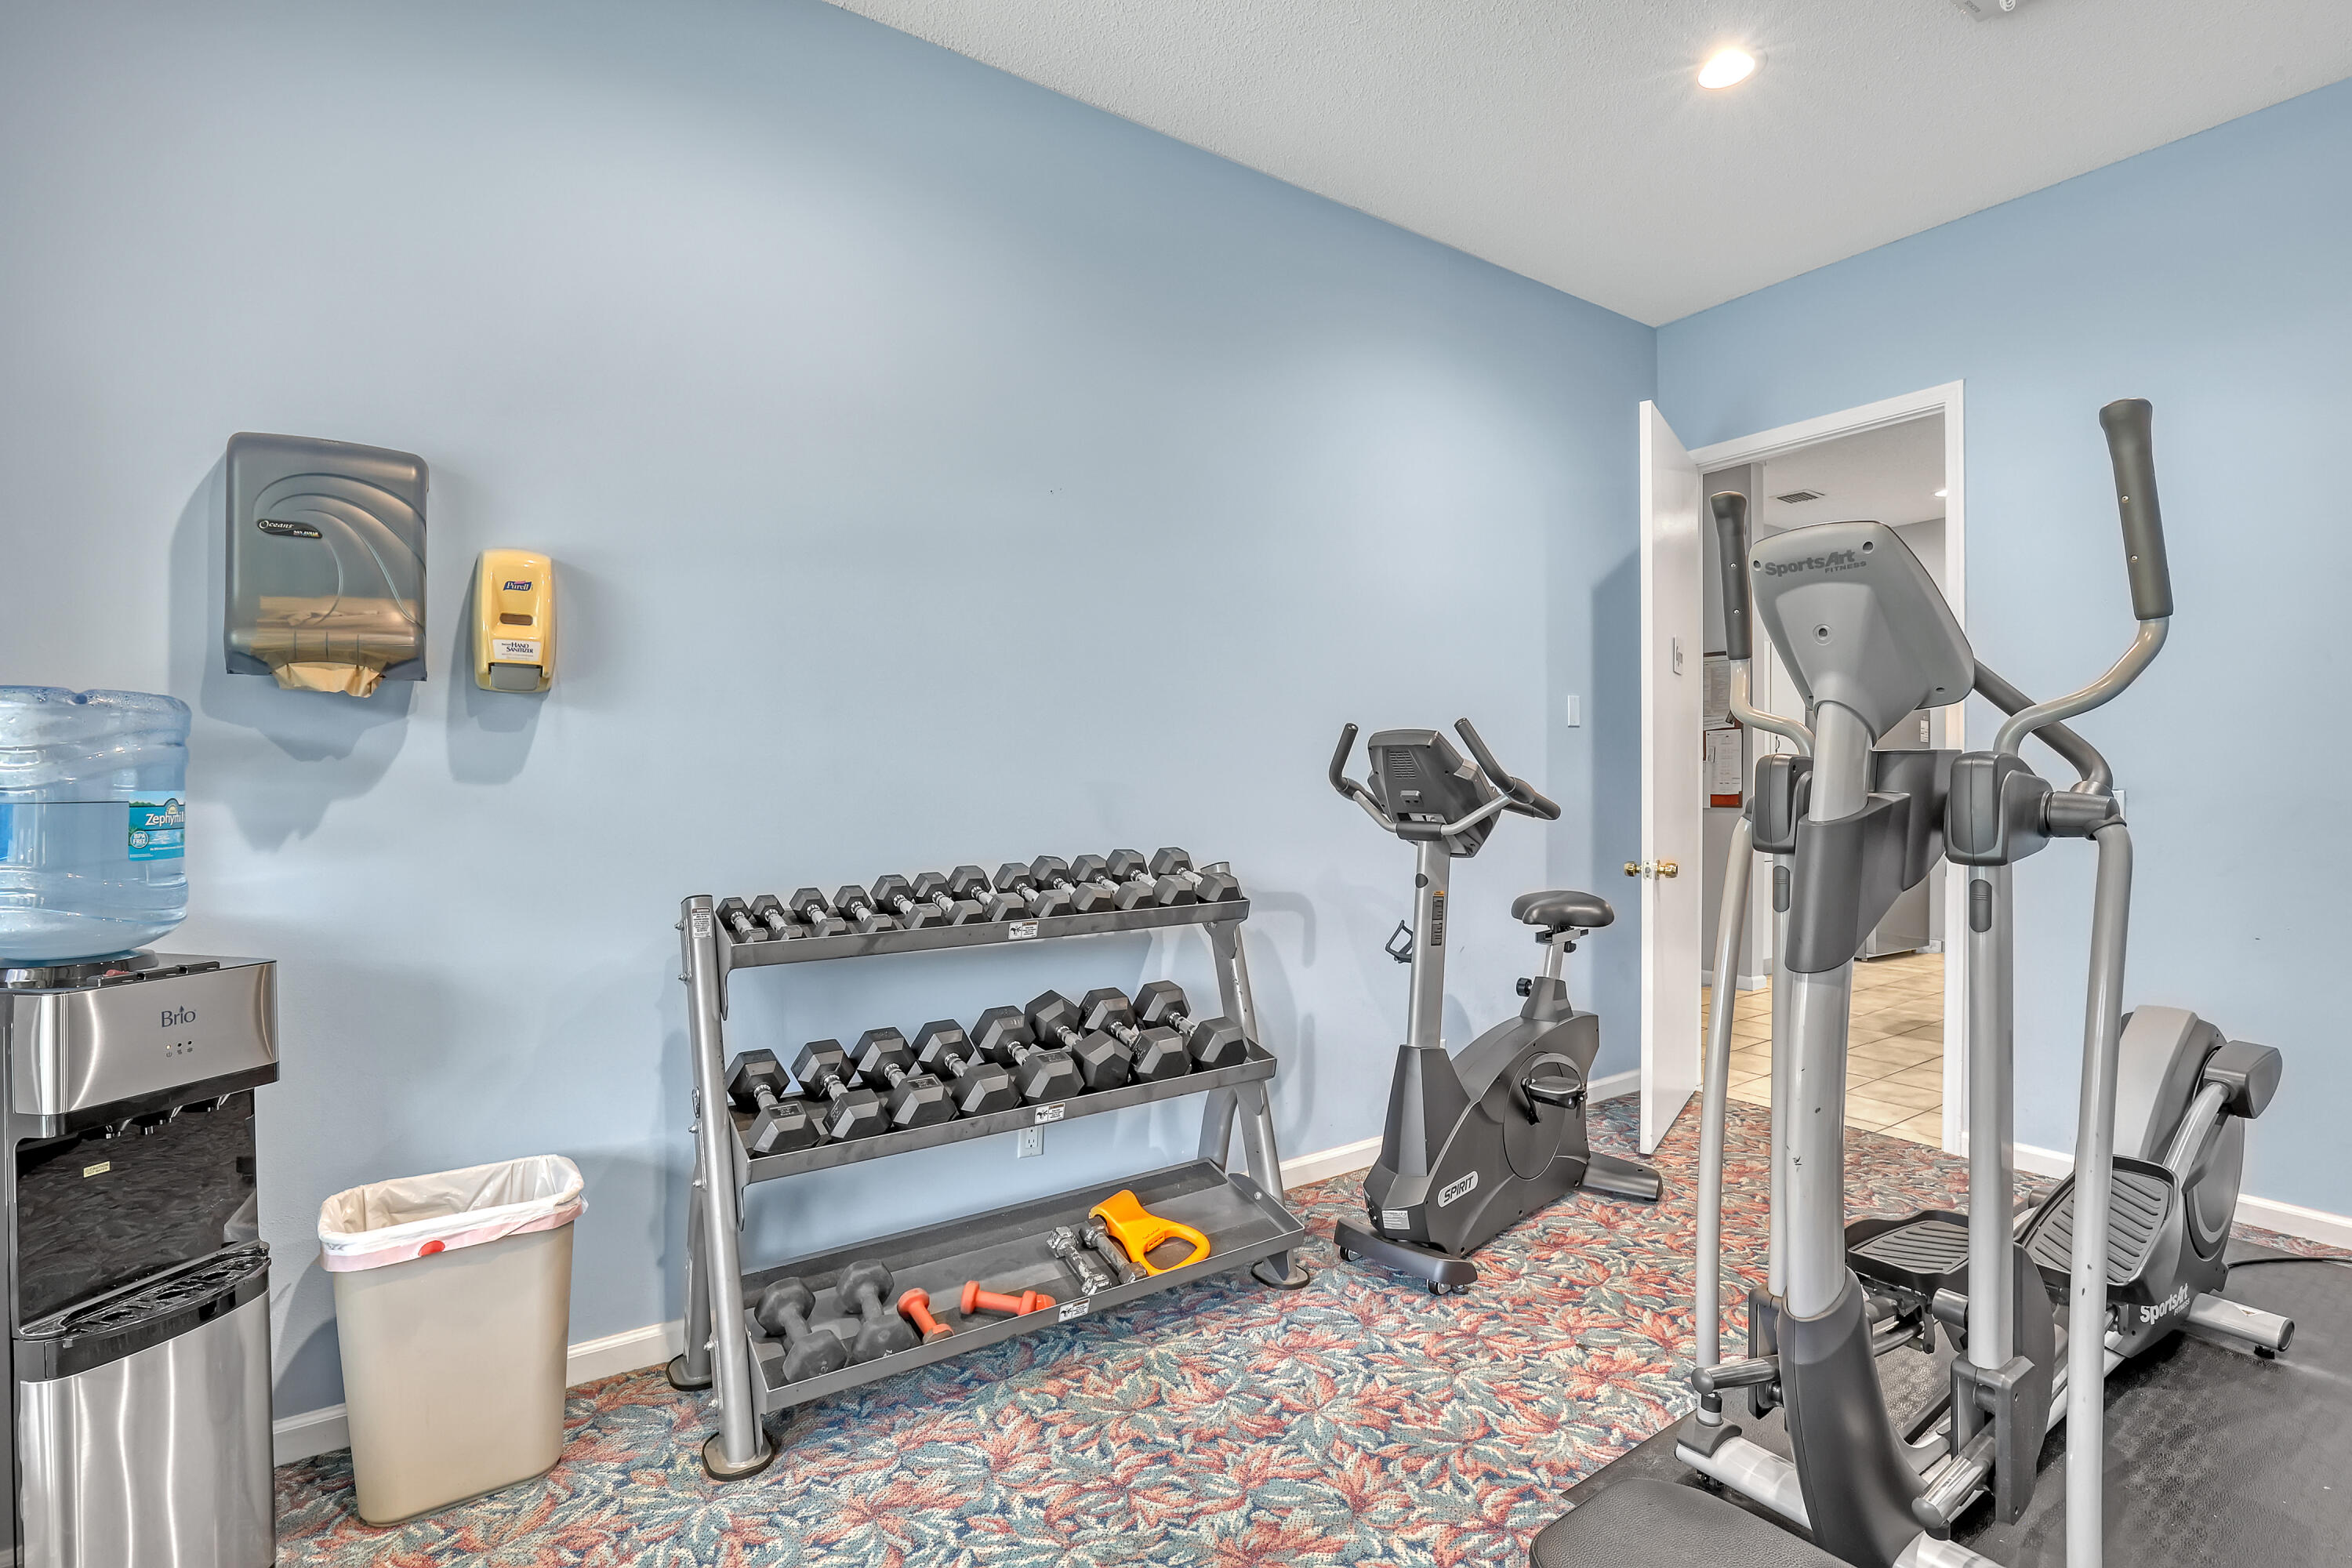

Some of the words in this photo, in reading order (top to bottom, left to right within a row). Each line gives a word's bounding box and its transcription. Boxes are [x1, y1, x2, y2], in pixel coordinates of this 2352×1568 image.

[259, 520, 294, 529] Oceans
[1765, 550, 1856, 577] SportsArt
[1824, 561, 1867, 574] FITNESS
[162, 1005, 196, 1028] Brio
[89, 1163, 109, 1171] CAUTION
[1443, 1175, 1474, 1203] SPIRIT
[2140, 1283, 2189, 1325] SportsArt
